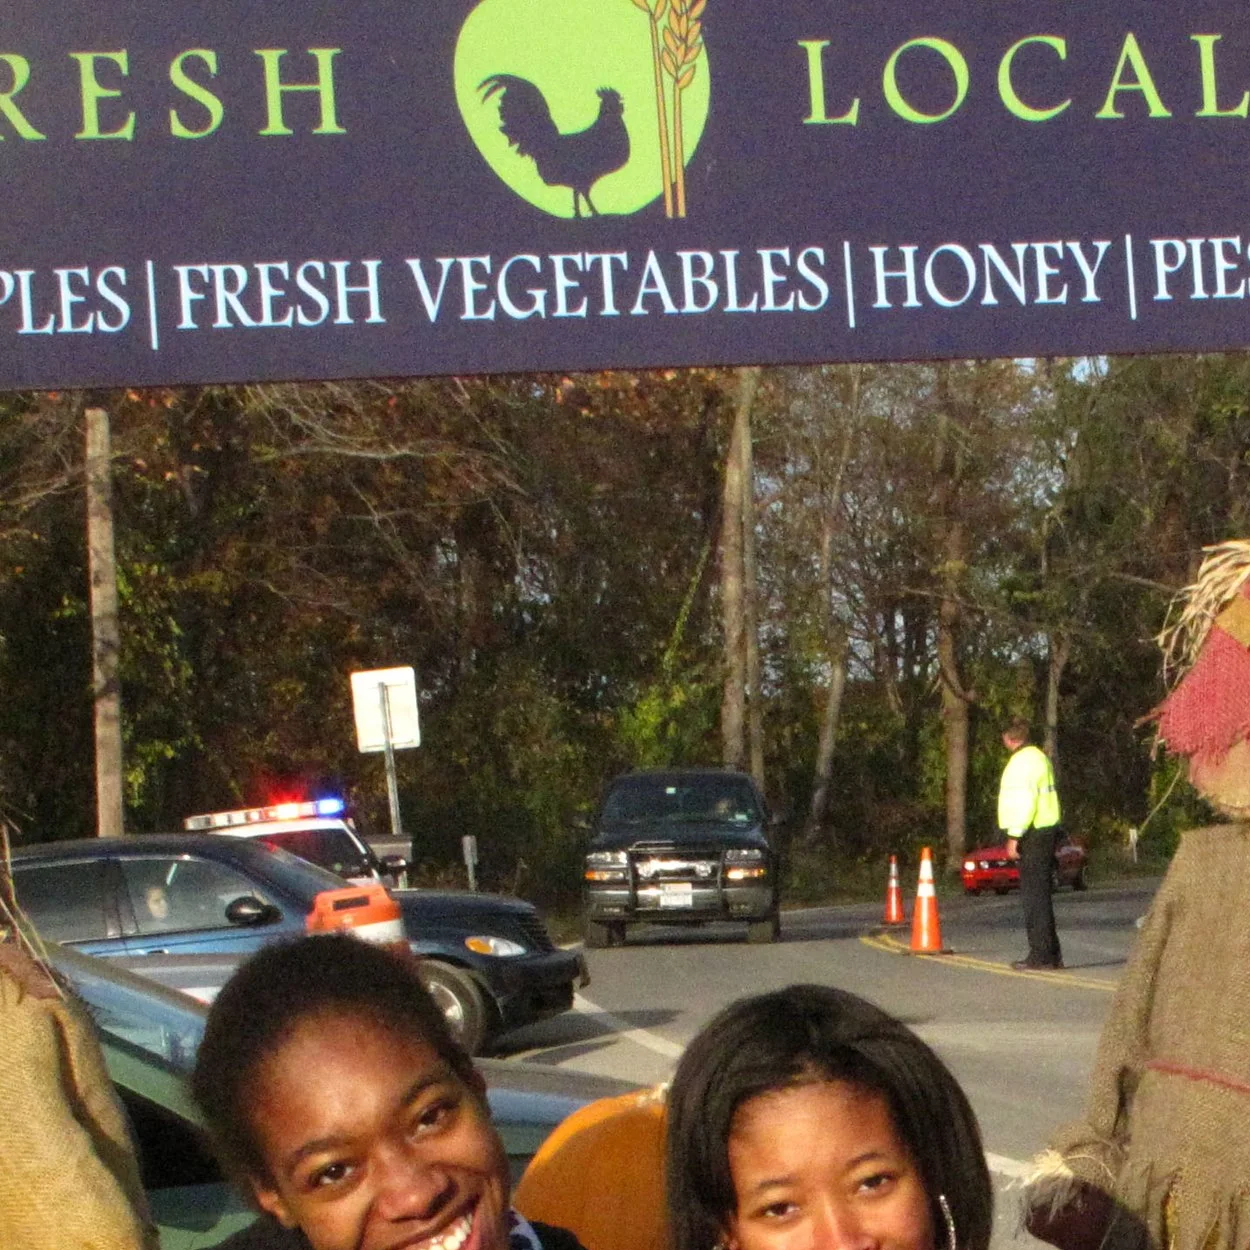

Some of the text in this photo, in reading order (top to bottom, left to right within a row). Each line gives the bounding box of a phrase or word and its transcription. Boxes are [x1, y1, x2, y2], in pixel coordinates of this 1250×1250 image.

[797, 32, 1250, 126] LOCAL
[173, 259, 386, 330] FRESH
[406, 246, 829, 322] VEGETABLES
[868, 241, 1112, 308] HONEY
